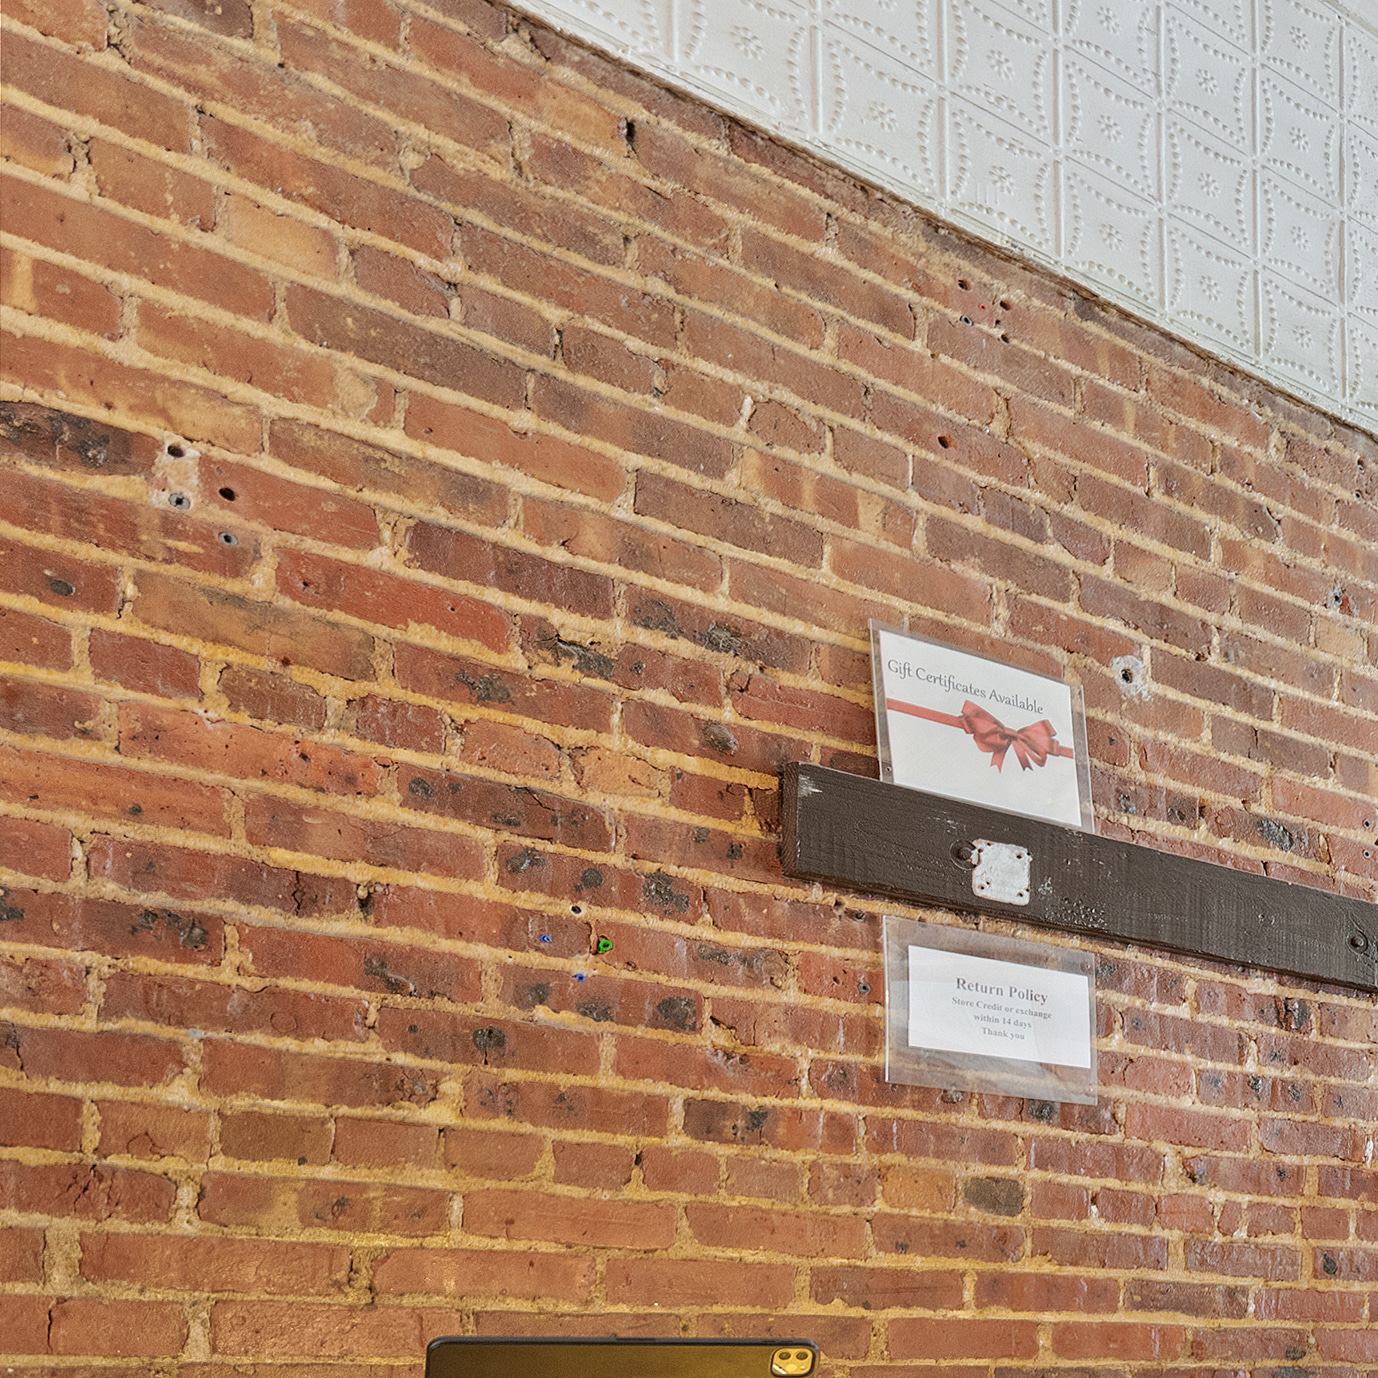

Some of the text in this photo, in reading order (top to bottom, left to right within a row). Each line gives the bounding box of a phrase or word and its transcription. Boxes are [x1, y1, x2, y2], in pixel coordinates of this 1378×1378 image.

[888, 659, 1044, 714] Gift Certificates Available
[956, 977, 1048, 1006] Return Policy
[951, 997, 975, 1007] Store
[976, 1000, 1003, 1011] Credit
[1015, 1008, 1052, 1020] exchange
[973, 1014, 1032, 1029] within 14 days
[981, 1027, 1025, 1041] Thank you
